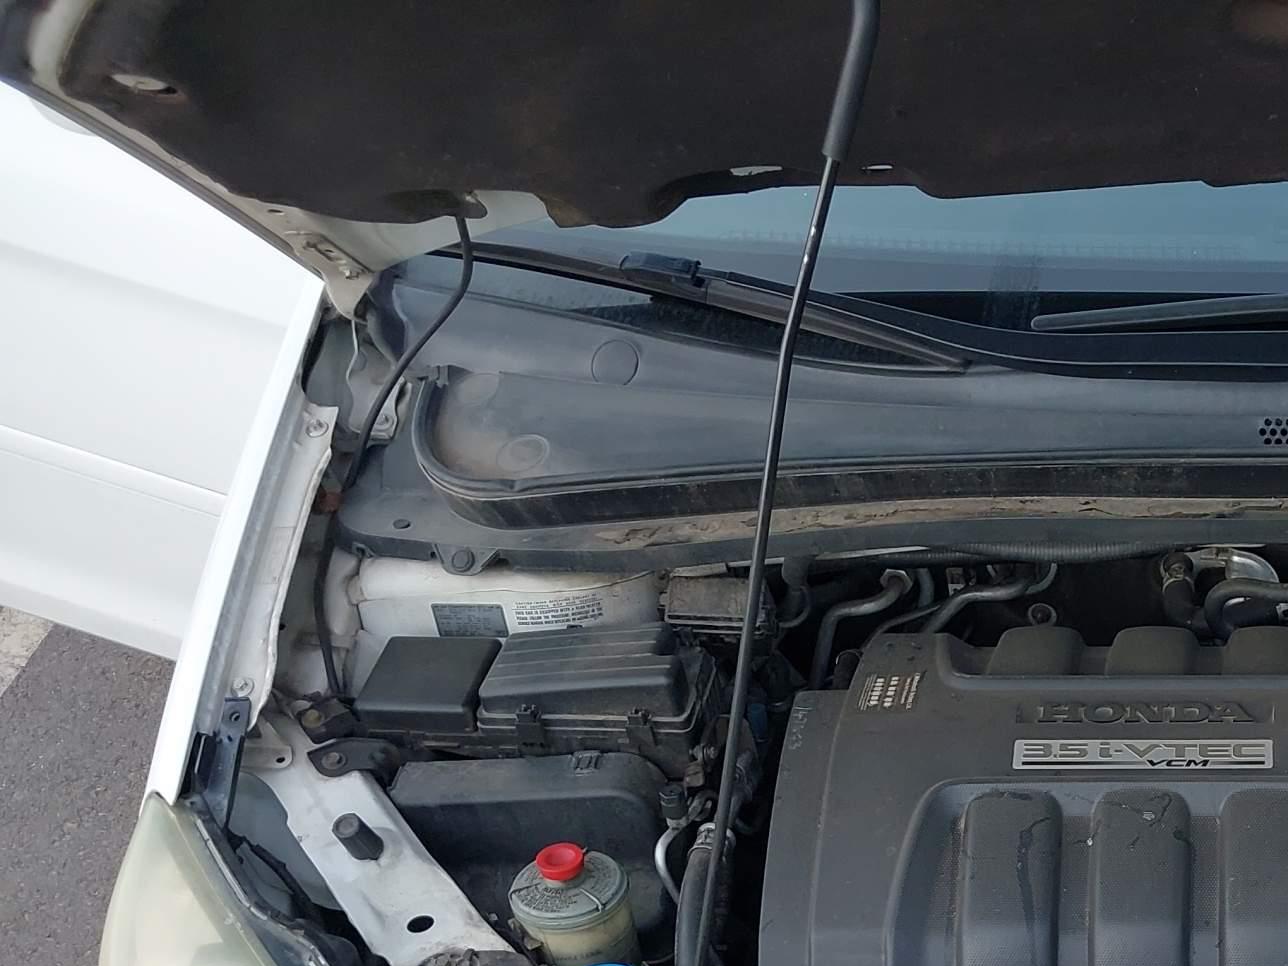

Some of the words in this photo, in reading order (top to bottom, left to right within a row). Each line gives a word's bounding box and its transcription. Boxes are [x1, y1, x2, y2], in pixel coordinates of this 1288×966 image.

[1035, 702, 1257, 723] HONDA
[1022, 743, 1089, 759] 3.5
[1099, 742, 1266, 759] i-VTEC
